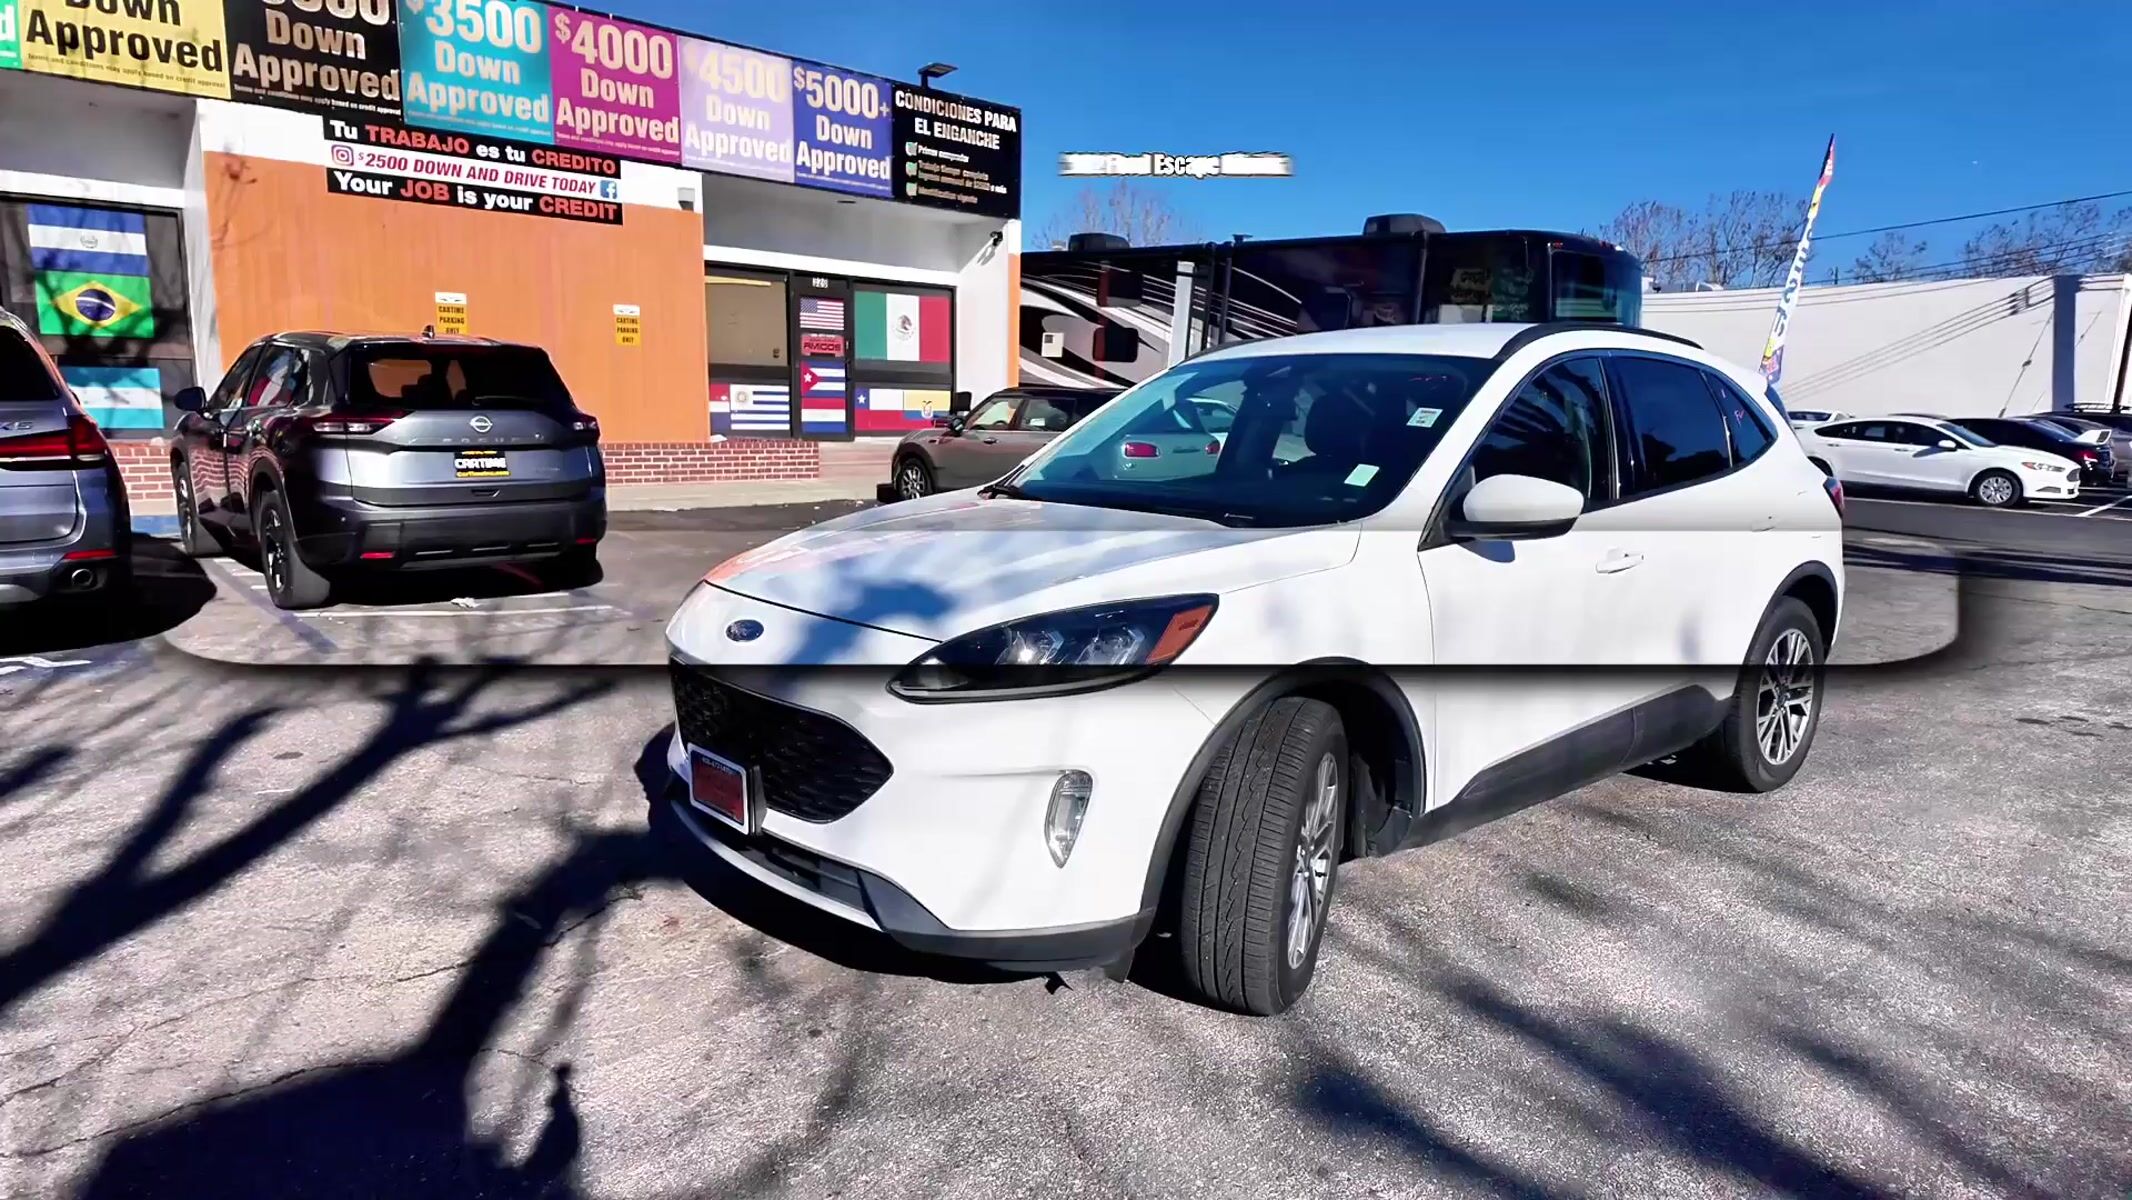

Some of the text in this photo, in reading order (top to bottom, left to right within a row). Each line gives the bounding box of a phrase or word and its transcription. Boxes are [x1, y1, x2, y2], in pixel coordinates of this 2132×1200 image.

[65, 0, 182, 26] own
[265, 9, 366, 60] Down
[26, 9, 223, 72] Approved
[435, 40, 521, 85] Down
[554, 12, 673, 80] $4000
[234, 43, 401, 101] Approved
[580, 68, 655, 109] Down
[793, 66, 890, 120] $5000+
[407, 72, 550, 123] Approved
[706, 95, 771, 130] Down
[895, 90, 1017, 132] CONDICIONES PARA
[557, 98, 680, 144] Approved
[684, 120, 792, 163] Approved
[816, 115, 873, 150] Down
[915, 117, 1000, 150] EL ENGANCHE
[330, 119, 616, 174] Tu TRABAJO es tu CREDITO
[796, 140, 890, 181] Approved
[333, 171, 617, 220] Your JOB is your CREDIT
[358, 152, 596, 195] $2500 DOWN AND DRIVE TODAY
